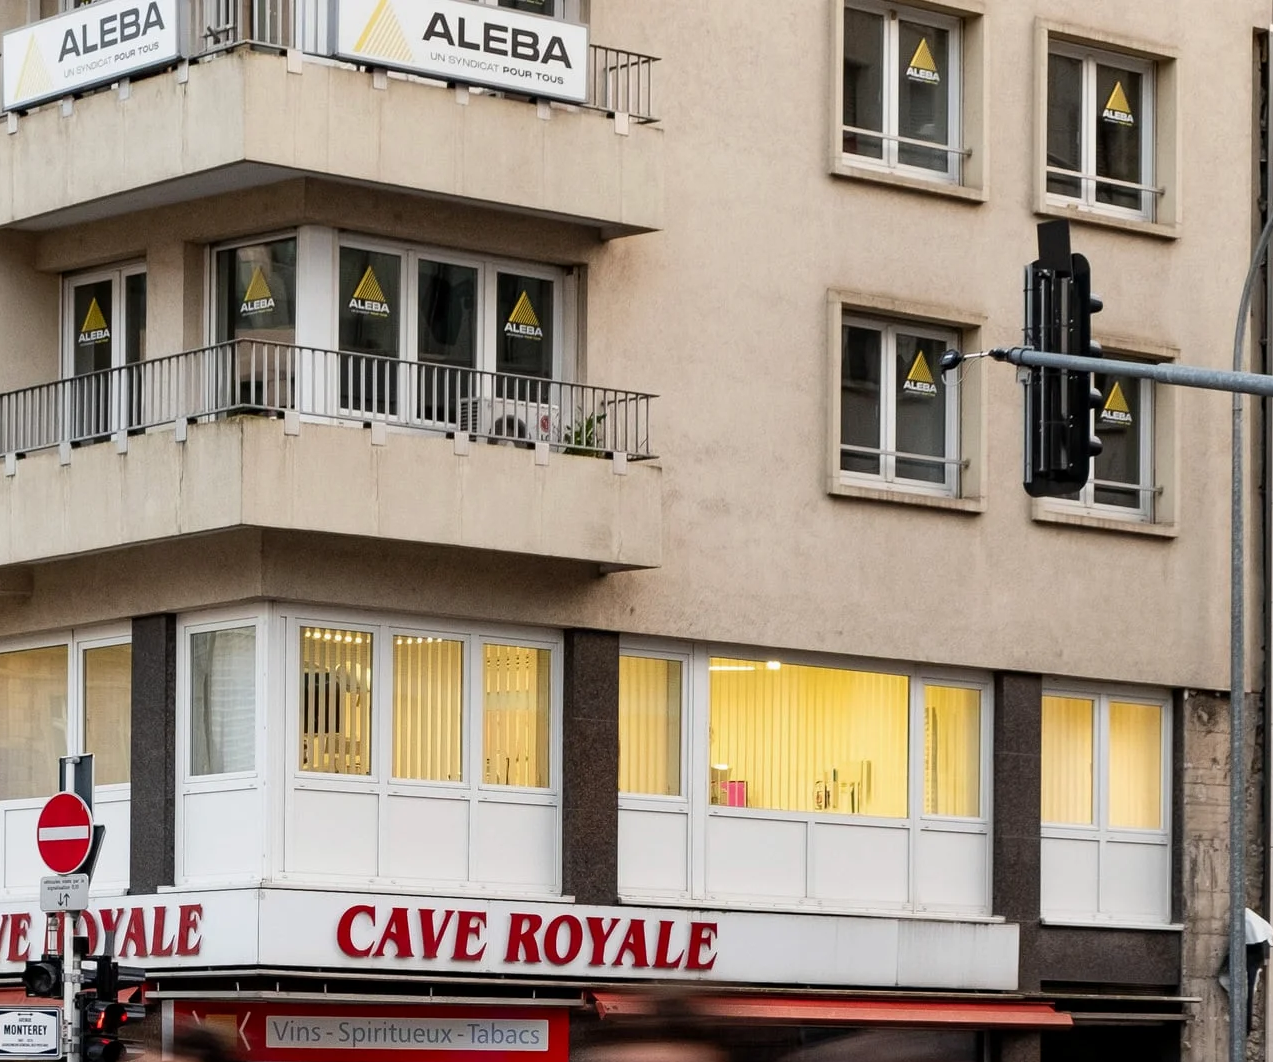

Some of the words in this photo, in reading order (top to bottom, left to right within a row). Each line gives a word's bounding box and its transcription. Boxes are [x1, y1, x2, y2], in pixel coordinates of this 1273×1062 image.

[58, 1, 165, 62] ALEBA
[422, 12, 572, 69] ALEBA
[64, 67, 74, 78] UN
[76, 56, 112, 75] SYNDICAT
[114, 50, 135, 63] POUR
[138, 42, 159, 54] TOUS
[430, 52, 445, 62] UN
[448, 55, 500, 73] SYNDICAT
[503, 66, 532, 78] POUR
[536, 72, 564, 85] TOUS
[906, 67, 940, 82] ALEBA
[1103, 110, 1134, 123] ALEBA
[240, 298, 275, 313] ALEBA
[349, 298, 390, 313] ALEBA
[78, 328, 110, 343] ALEBA
[504, 322, 543, 337] ALEBA
[903, 380, 937, 393] ALEBA
[1100, 409, 1132, 422] ALEBA
[337, 904, 487, 961] CAVE
[503, 913, 718, 971] ROYALE
[3, 1024, 47, 1035] MONTEREY
[273, 1021, 321, 1041] Vins
[338, 1021, 453, 1048] Spiritueux
[466, 1023, 541, 1044] Tabacs
